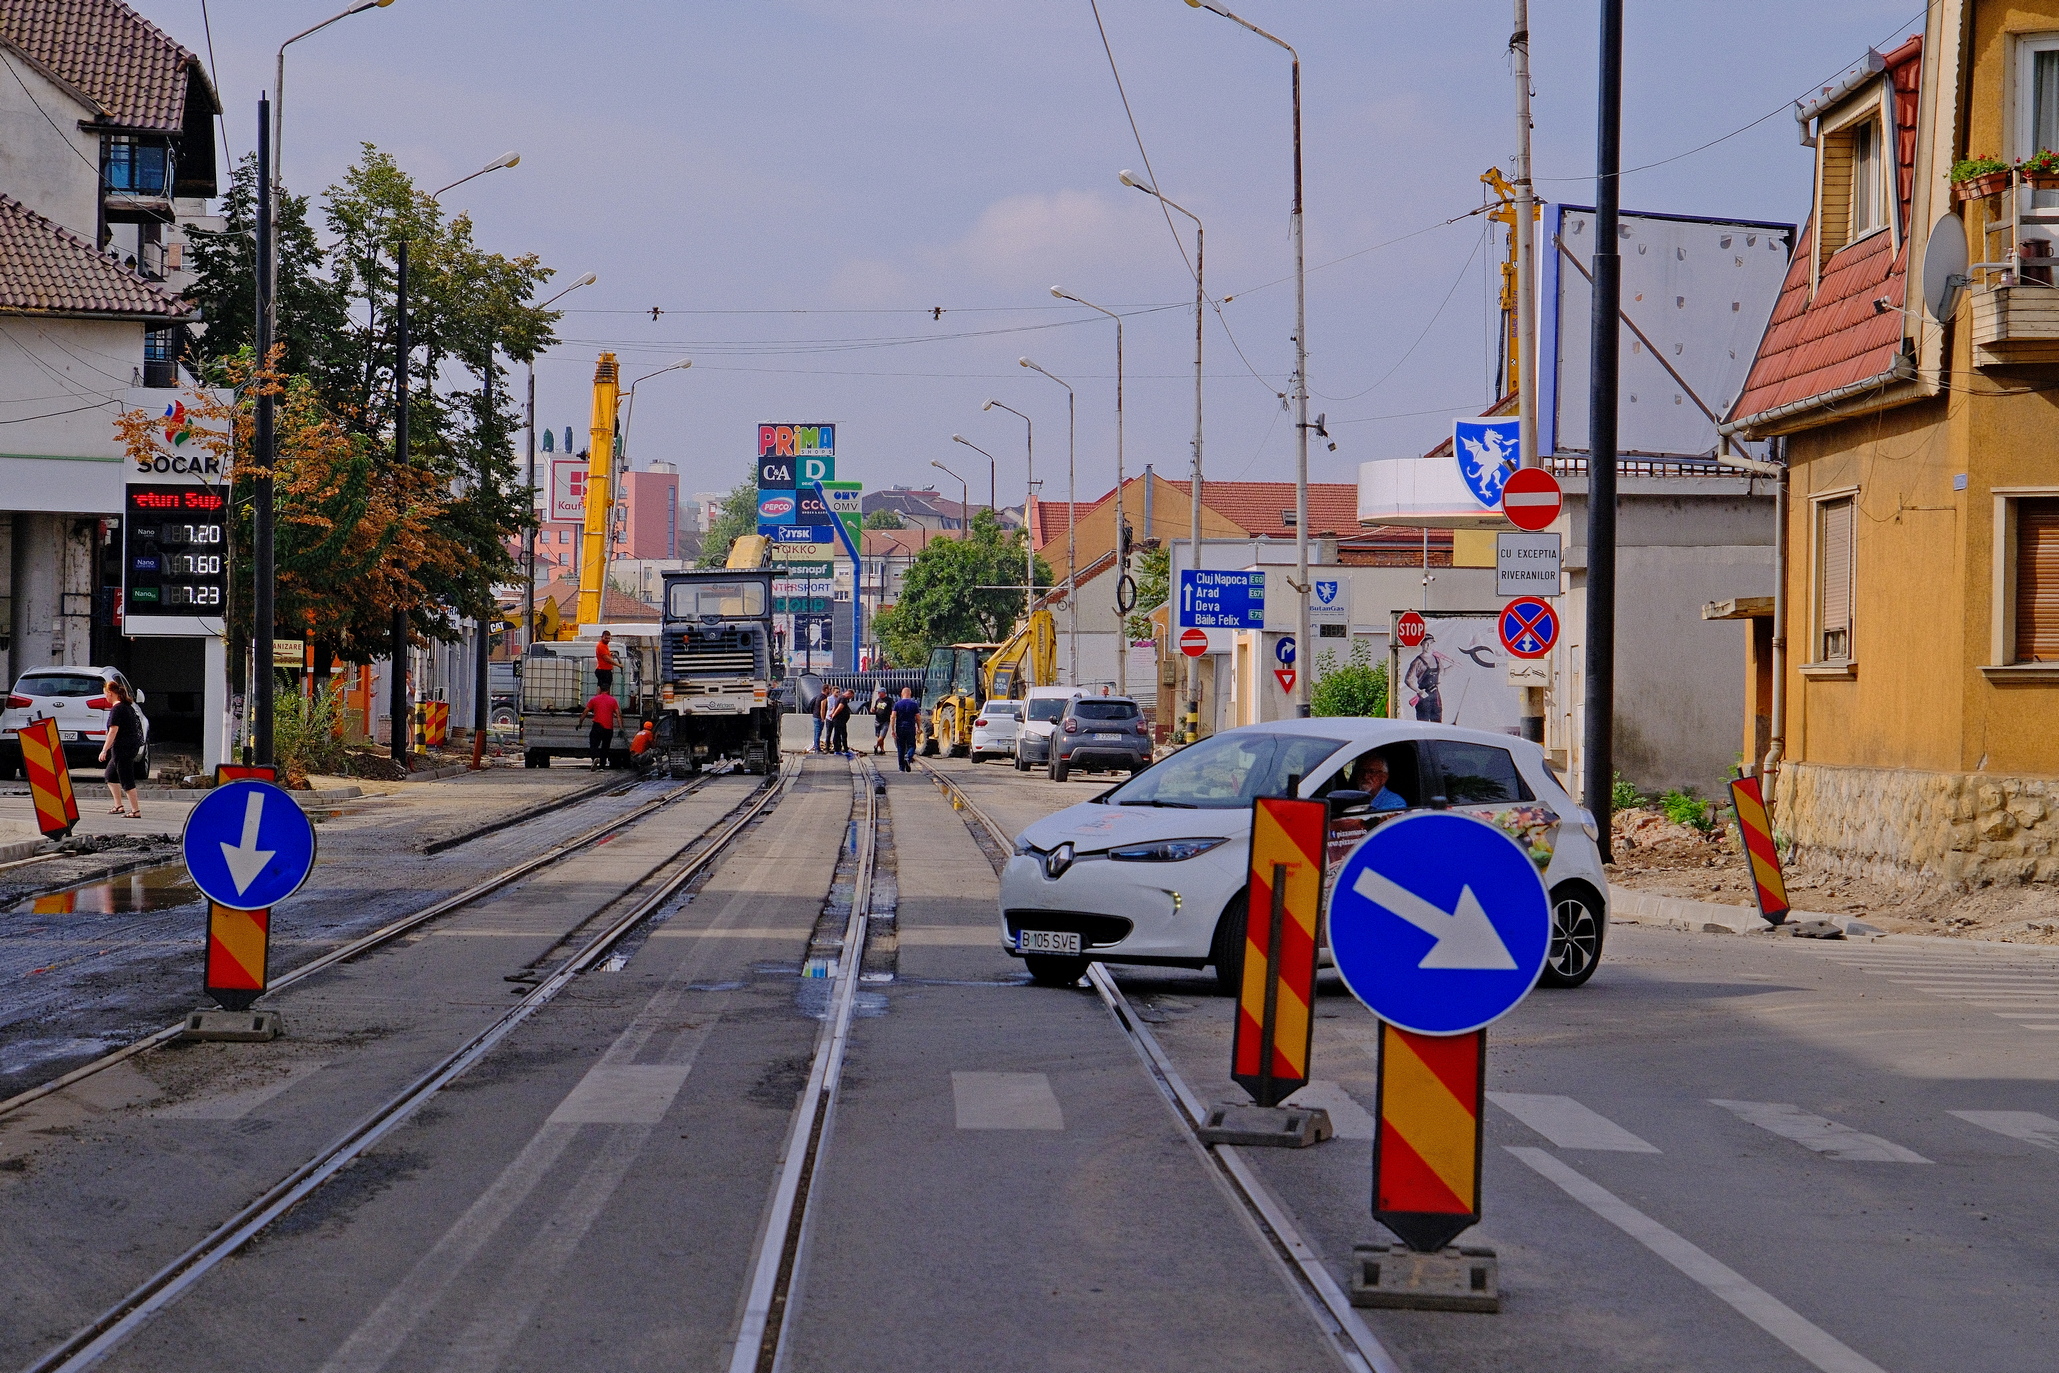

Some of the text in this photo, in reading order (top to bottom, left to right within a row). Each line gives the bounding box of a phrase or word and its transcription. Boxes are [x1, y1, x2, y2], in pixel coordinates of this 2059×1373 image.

[137, 456, 220, 474] SOCAR
[805, 459, 826, 480] D
[763, 465, 791, 480] C&A
[558, 501, 583, 511] Kauf
[764, 503, 790, 511] PEPCO
[833, 503, 858, 511] OMV
[184, 525, 220, 543] 7.20
[785, 530, 810, 538] JYSK
[1500, 549, 1557, 559] CU EXCEPTIA
[184, 556, 220, 574] 7.60
[1196, 573, 1263, 587] Cluj Napoca E60
[1501, 571, 1556, 580] RIVERANILOR
[771, 584, 831, 592] NTERSPORT
[1196, 587, 1220, 598] Arad
[183, 586, 220, 604] 7.23
[1195, 601, 1220, 612] Deva
[1218, 614, 1240, 626] Felix
[490, 621, 504, 633] CAT
[1399, 622, 1424, 636] STOP
[1022, 932, 1077, 950] B 105 SVE
